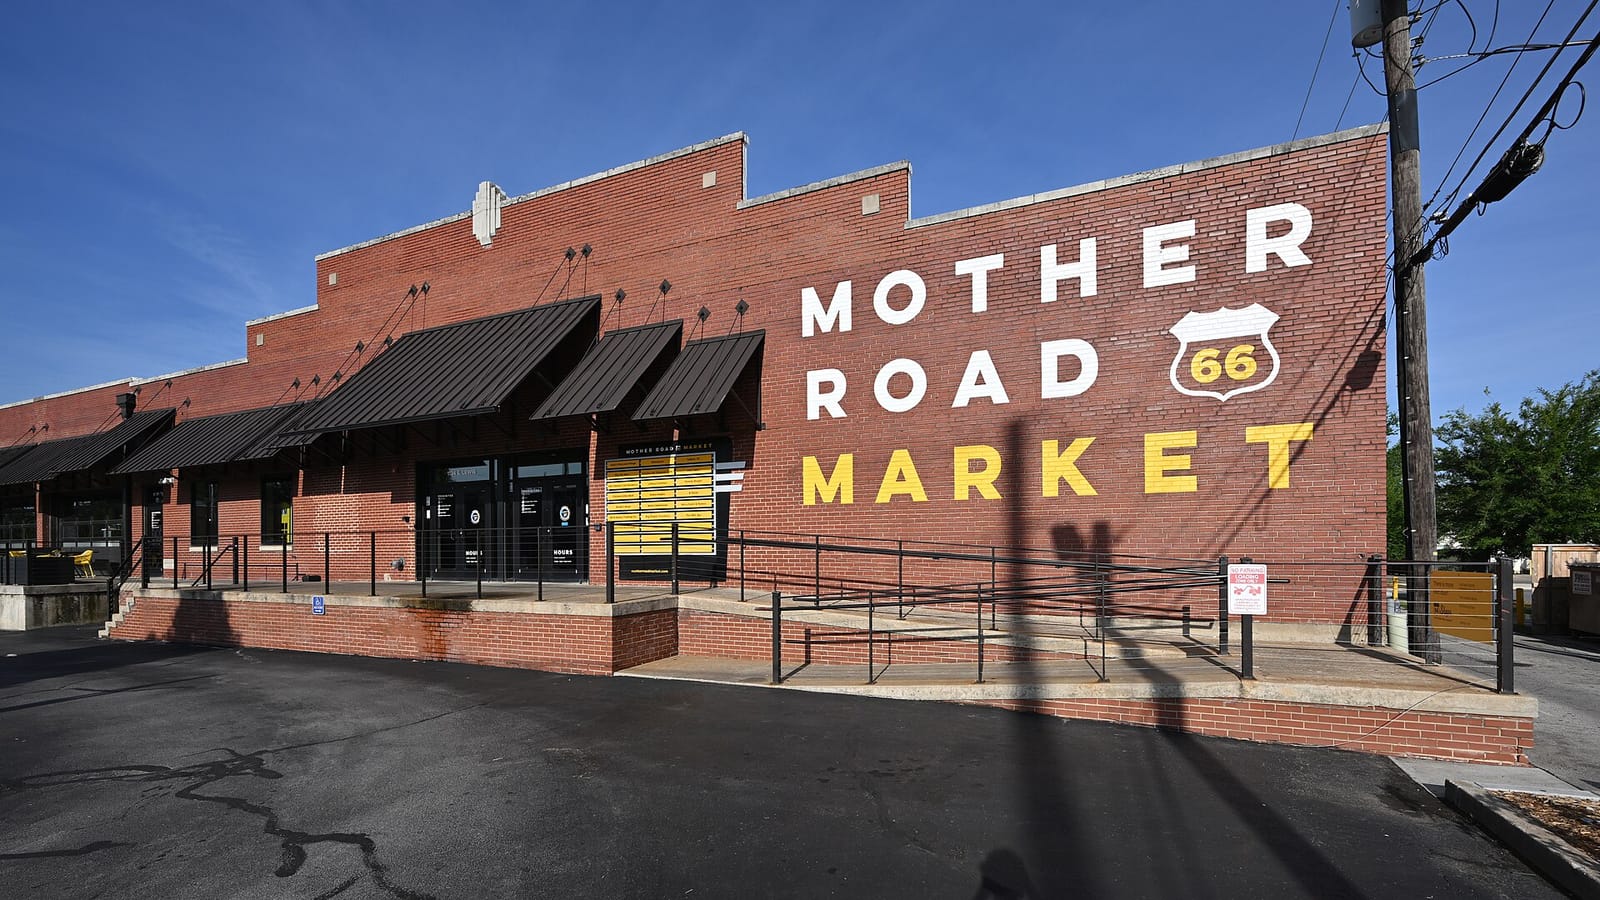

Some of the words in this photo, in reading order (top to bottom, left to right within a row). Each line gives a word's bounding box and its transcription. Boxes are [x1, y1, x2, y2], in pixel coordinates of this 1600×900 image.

[801, 202, 1314, 338] MOTHER
[806, 338, 1099, 421] ROAD
[1190, 344, 1258, 384] 66
[626, 447, 653, 455] MOTHER
[801, 422, 1314, 508] MARKET
